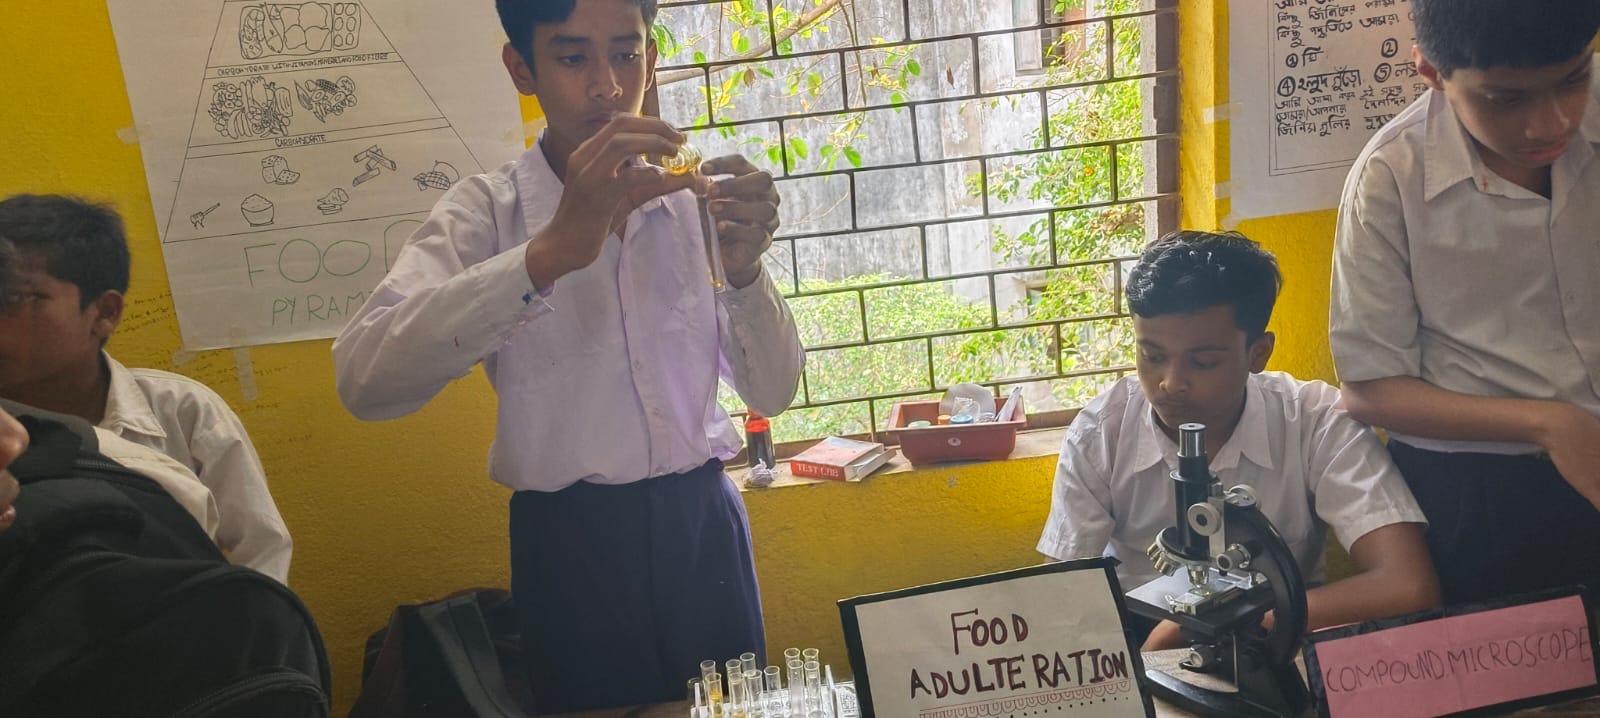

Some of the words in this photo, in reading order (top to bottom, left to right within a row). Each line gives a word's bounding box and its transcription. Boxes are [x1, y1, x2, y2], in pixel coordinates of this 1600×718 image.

[1360, 14, 1399, 27] আমরা
[272, 290, 373, 326] PYRAM
[951, 608, 1029, 655] FOOD
